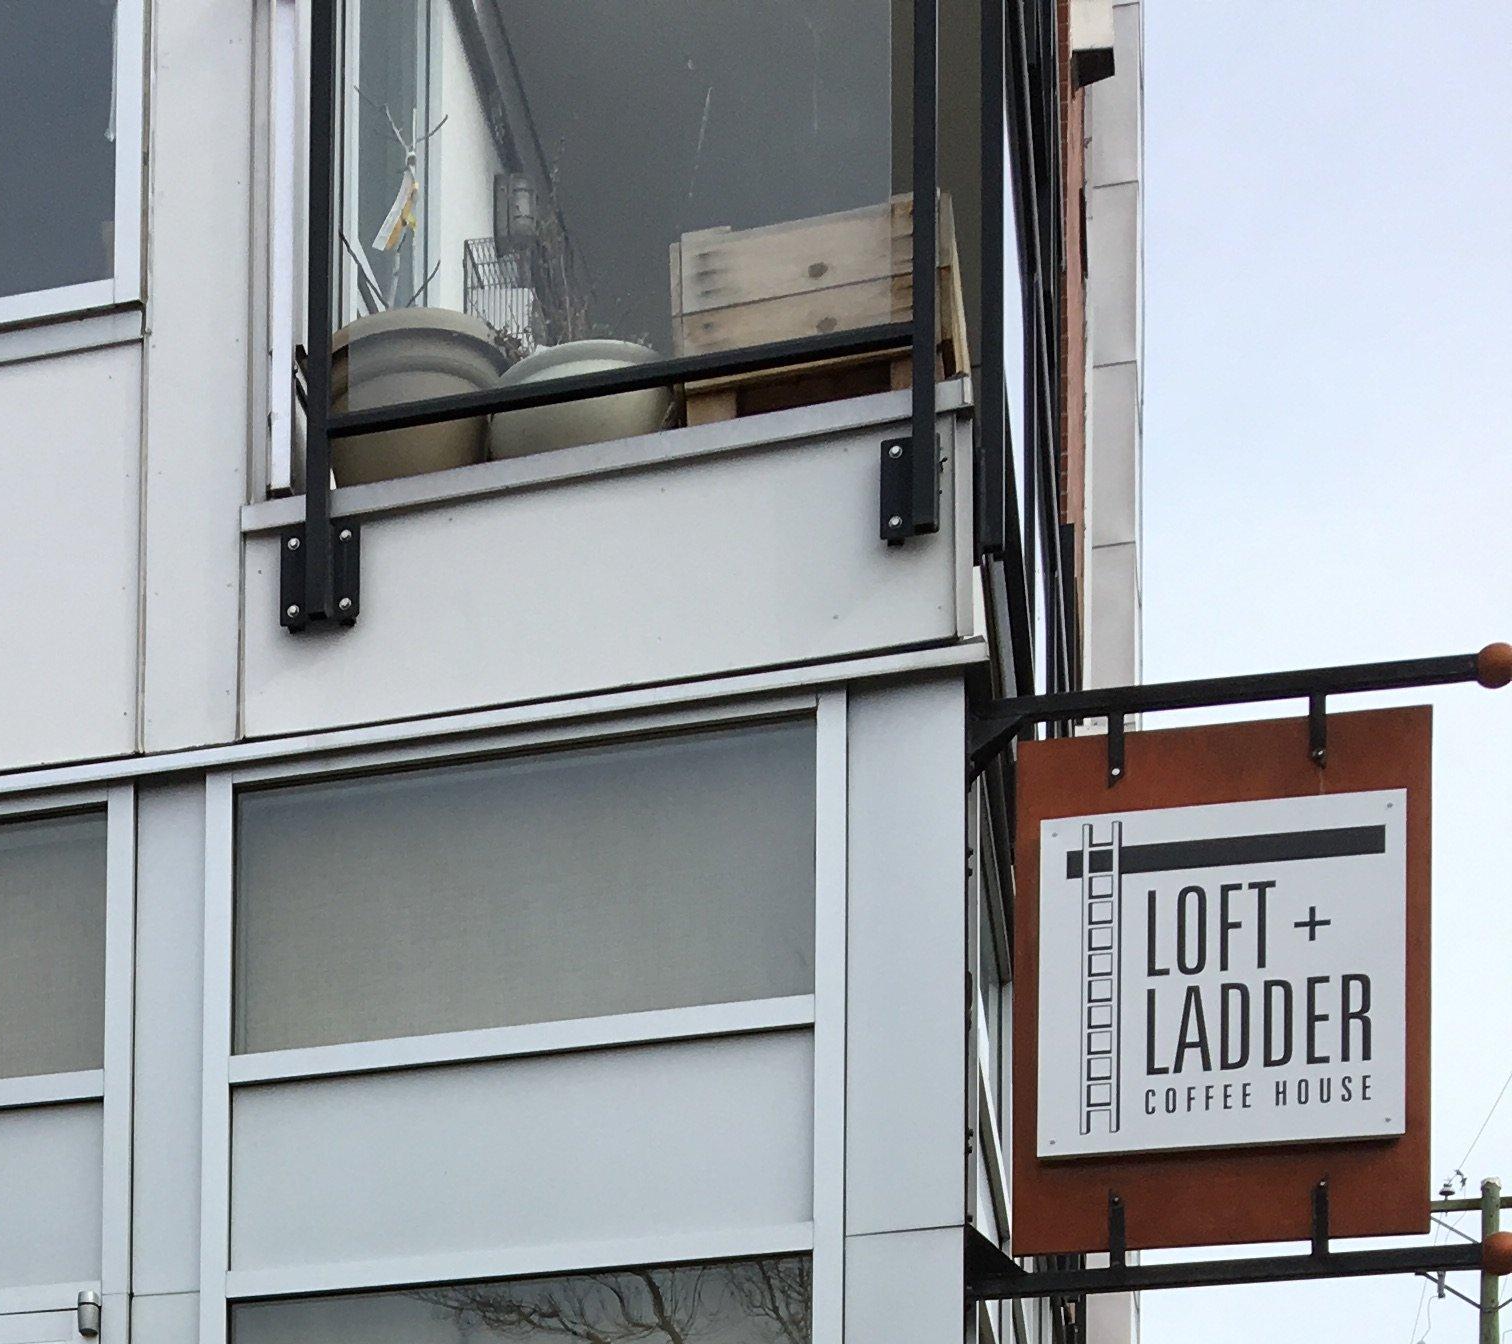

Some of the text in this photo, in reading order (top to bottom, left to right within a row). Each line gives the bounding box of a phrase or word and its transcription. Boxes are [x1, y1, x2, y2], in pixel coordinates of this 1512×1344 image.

[1146, 879, 1277, 977] LOFT
[1144, 972, 1373, 1076] LADDER
[1144, 1074, 1373, 1115] COFFEE HOUSE
